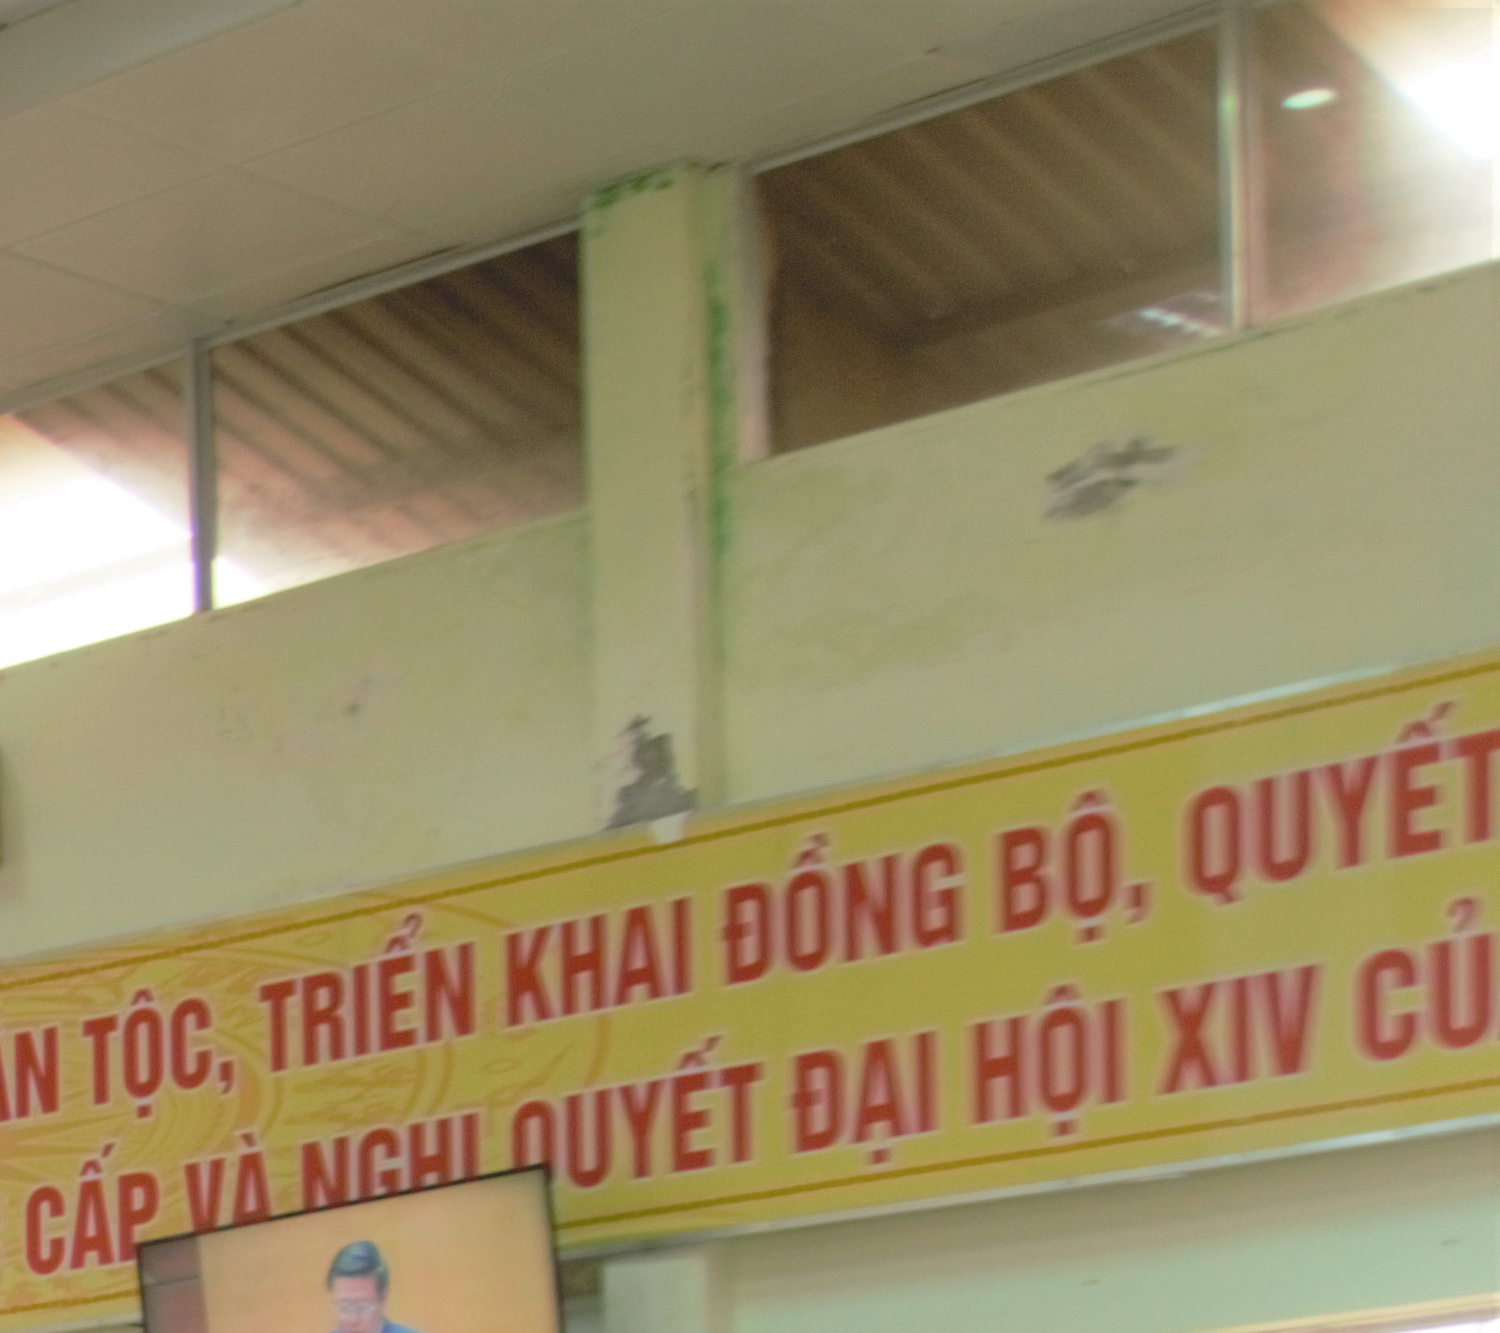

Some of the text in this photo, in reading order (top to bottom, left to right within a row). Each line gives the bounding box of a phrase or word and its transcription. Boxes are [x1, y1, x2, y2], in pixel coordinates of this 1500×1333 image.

[24, 1144, 160, 1275] CẤP
[184, 1133, 271, 1234] VÀ
[792, 1031, 938, 1166] ĐẠI
[970, 984, 1125, 1138] HỘI
[1157, 964, 1317, 1096] XIV
[1354, 896, 1500, 1061] CỦ
[84, 990, 235, 1118] TỘC,
[259, 914, 475, 1072] TRIỂN
[505, 897, 693, 1028] KHAI
[996, 789, 1153, 943] BỘ,
[1186, 700, 1500, 905] QUYẾT
